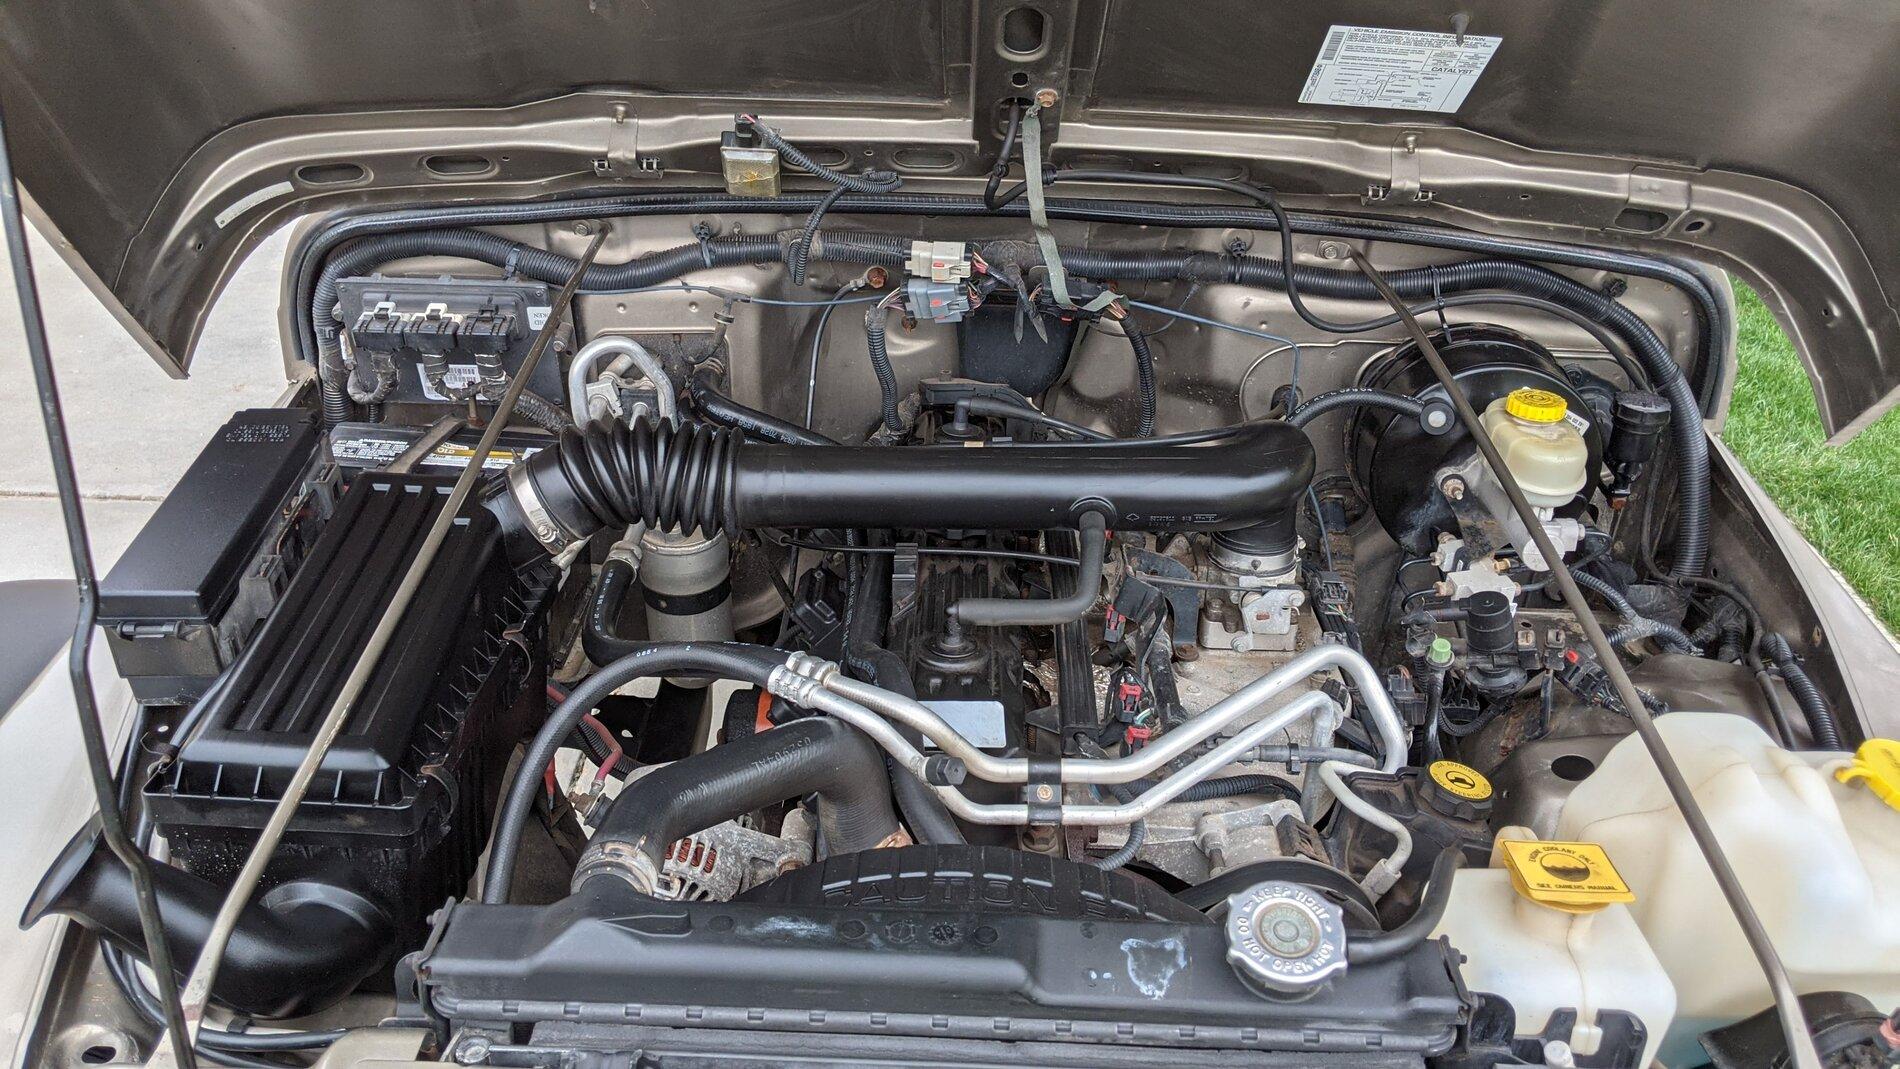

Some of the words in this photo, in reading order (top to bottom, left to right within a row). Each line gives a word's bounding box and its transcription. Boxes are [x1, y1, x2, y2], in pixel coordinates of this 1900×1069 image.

[1442, 34, 1486, 42] INFOATION
[1431, 66, 1474, 75] CATALYST
[1542, 846, 1576, 855] COOLANT
[1579, 854, 1596, 865] ONLY
[1252, 886, 1291, 903] KEEP
[1272, 960, 1314, 974] OPEN
